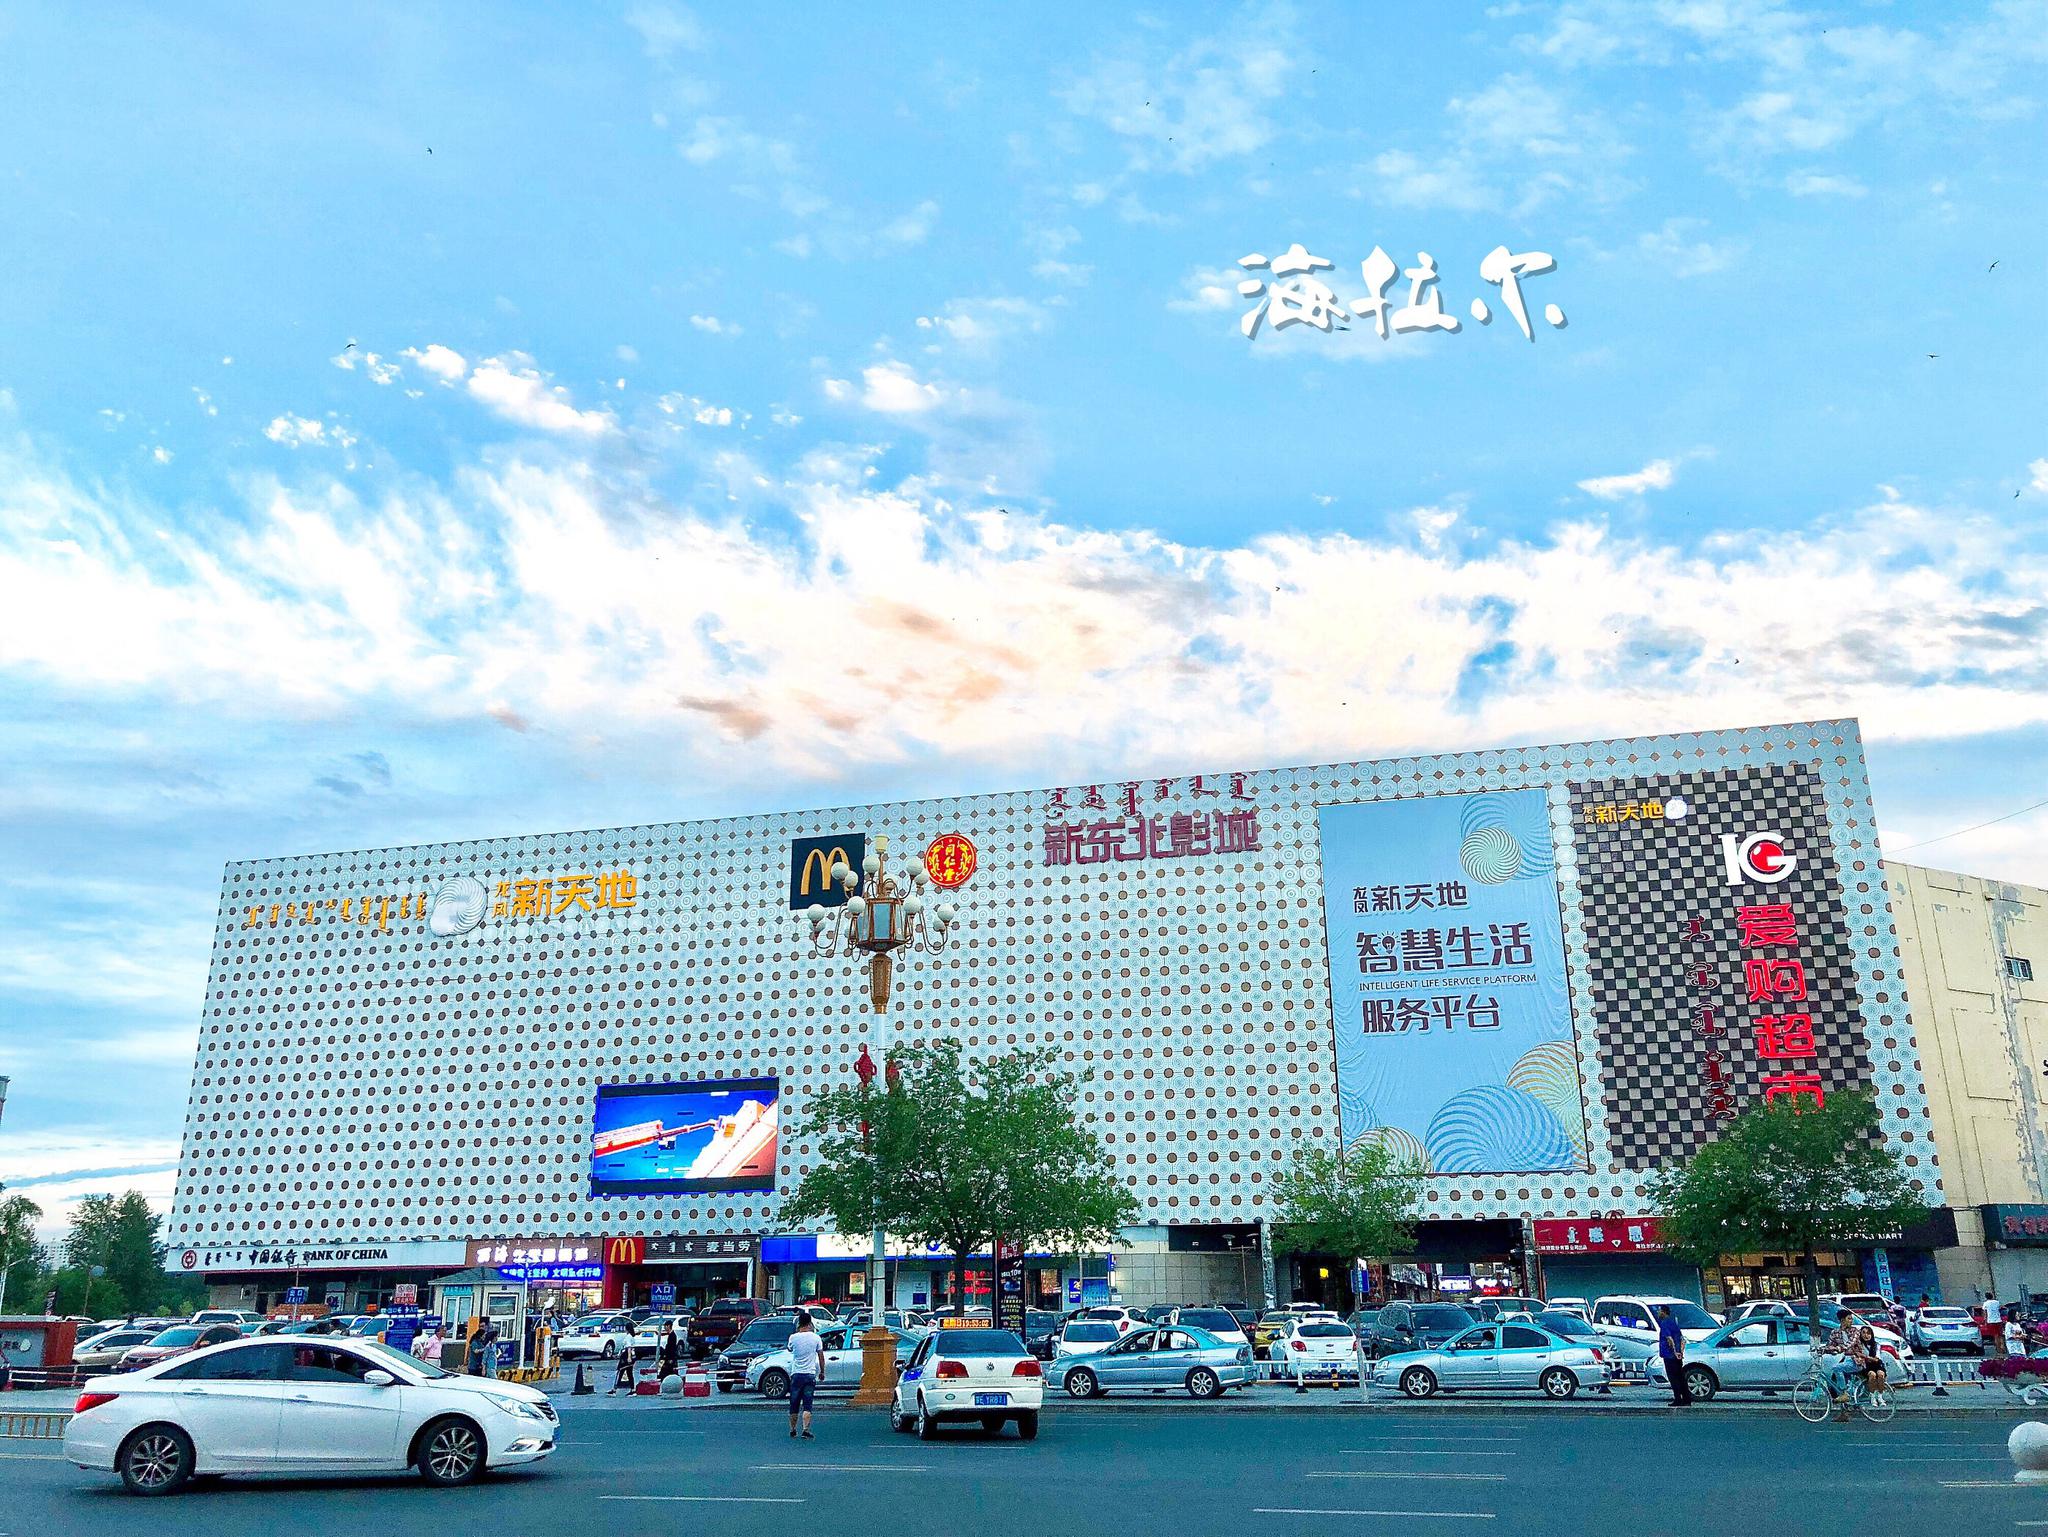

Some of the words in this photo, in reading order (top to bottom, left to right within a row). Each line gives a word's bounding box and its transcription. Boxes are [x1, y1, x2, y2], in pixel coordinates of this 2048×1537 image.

[1043, 811, 1259, 868] 新东北影城
[943, 844, 956, 882] 同仁堂
[492, 869, 638, 918] 龙凤新天地
[1352, 880, 1468, 914] 龙凤新天地
[1356, 922, 1533, 974] 智慧生活
[1359, 979, 1418, 991] INTELLIGENT
[1421, 978, 1440, 988] LIFE
[1442, 976, 1481, 987] SERVICE
[1483, 973, 1537, 984] PLATFORM
[1362, 993, 1500, 1034] 服务平台
[1736, 902, 1825, 1116] 爱购超市
[249, 1249, 298, 1265] 中国银行
[303, 1250, 334, 1261] BANK
[335, 1250, 351, 1260] OF
[351, 1249, 388, 1260] CHINA
[706, 1240, 751, 1252] 麦当劳
[655, 1286, 671, 1294] 入口
